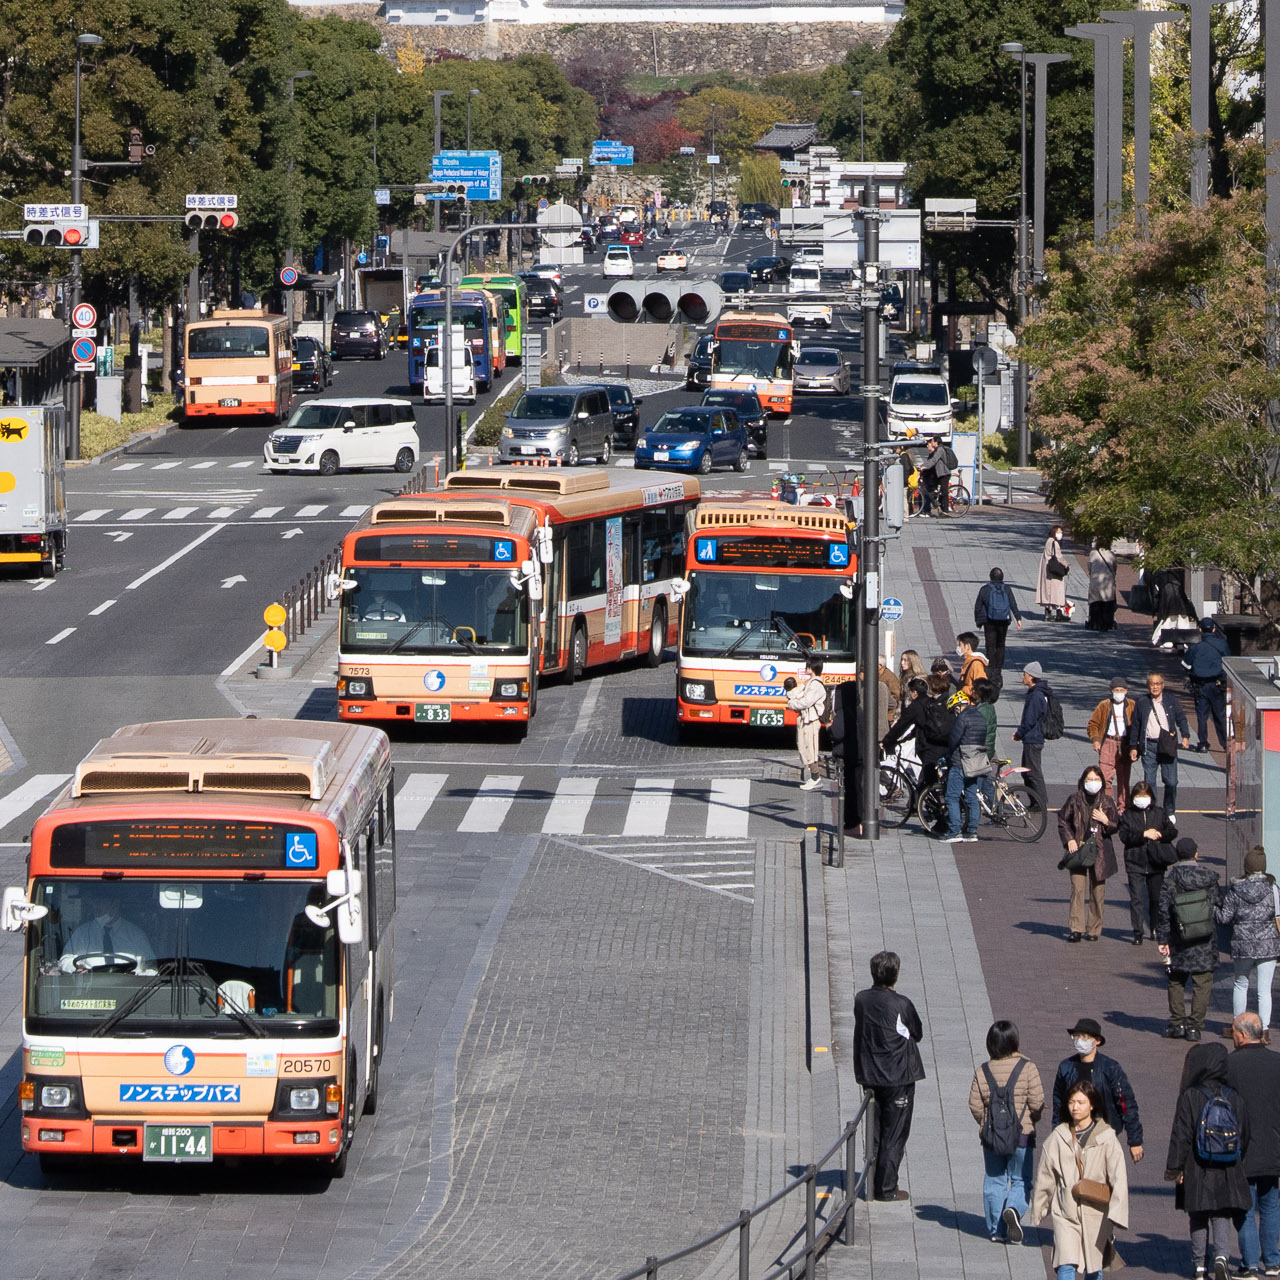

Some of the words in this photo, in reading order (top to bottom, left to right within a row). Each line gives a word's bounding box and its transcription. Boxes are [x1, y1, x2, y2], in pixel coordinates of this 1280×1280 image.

[187, 197, 236, 207] 時差式信号
[26, 205, 83, 218] 時差式信号
[78, 312, 91, 323] 40
[348, 667, 371, 676] 7573
[756, 714, 784, 725] 16-35
[283, 1059, 331, 1073] 20570
[122, 1086, 238, 1101] ノンステップバス
[175, 1128, 192, 1136] 200
[160, 1135, 207, 1155] 11-44
